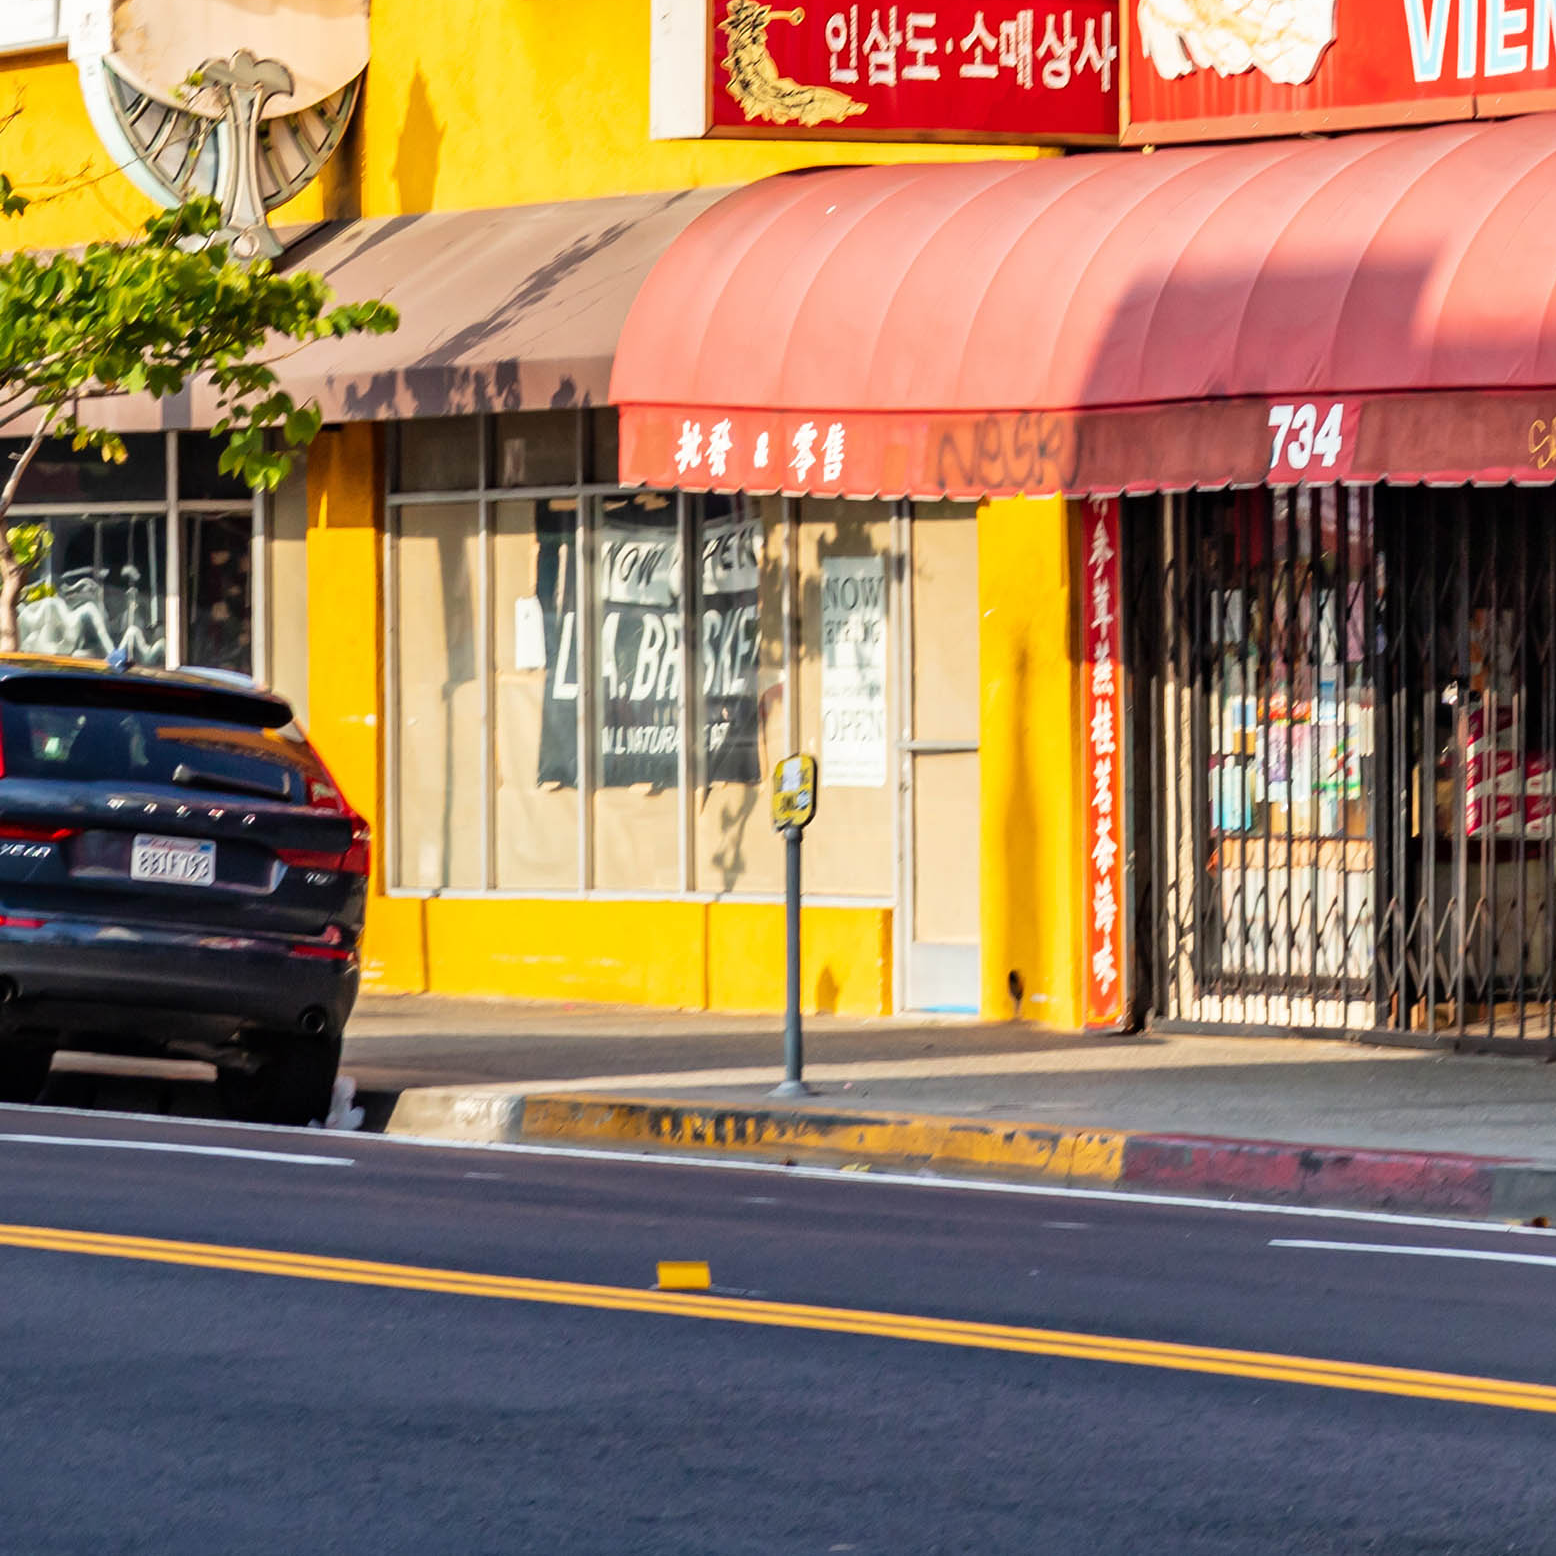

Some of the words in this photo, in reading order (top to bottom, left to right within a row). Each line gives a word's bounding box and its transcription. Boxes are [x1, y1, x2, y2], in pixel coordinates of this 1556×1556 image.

[1267, 402, 1344, 470] 734
[823, 576, 885, 612] NOW
[629, 603, 763, 703] BRSKE
[627, 722, 683, 757] NATURA
